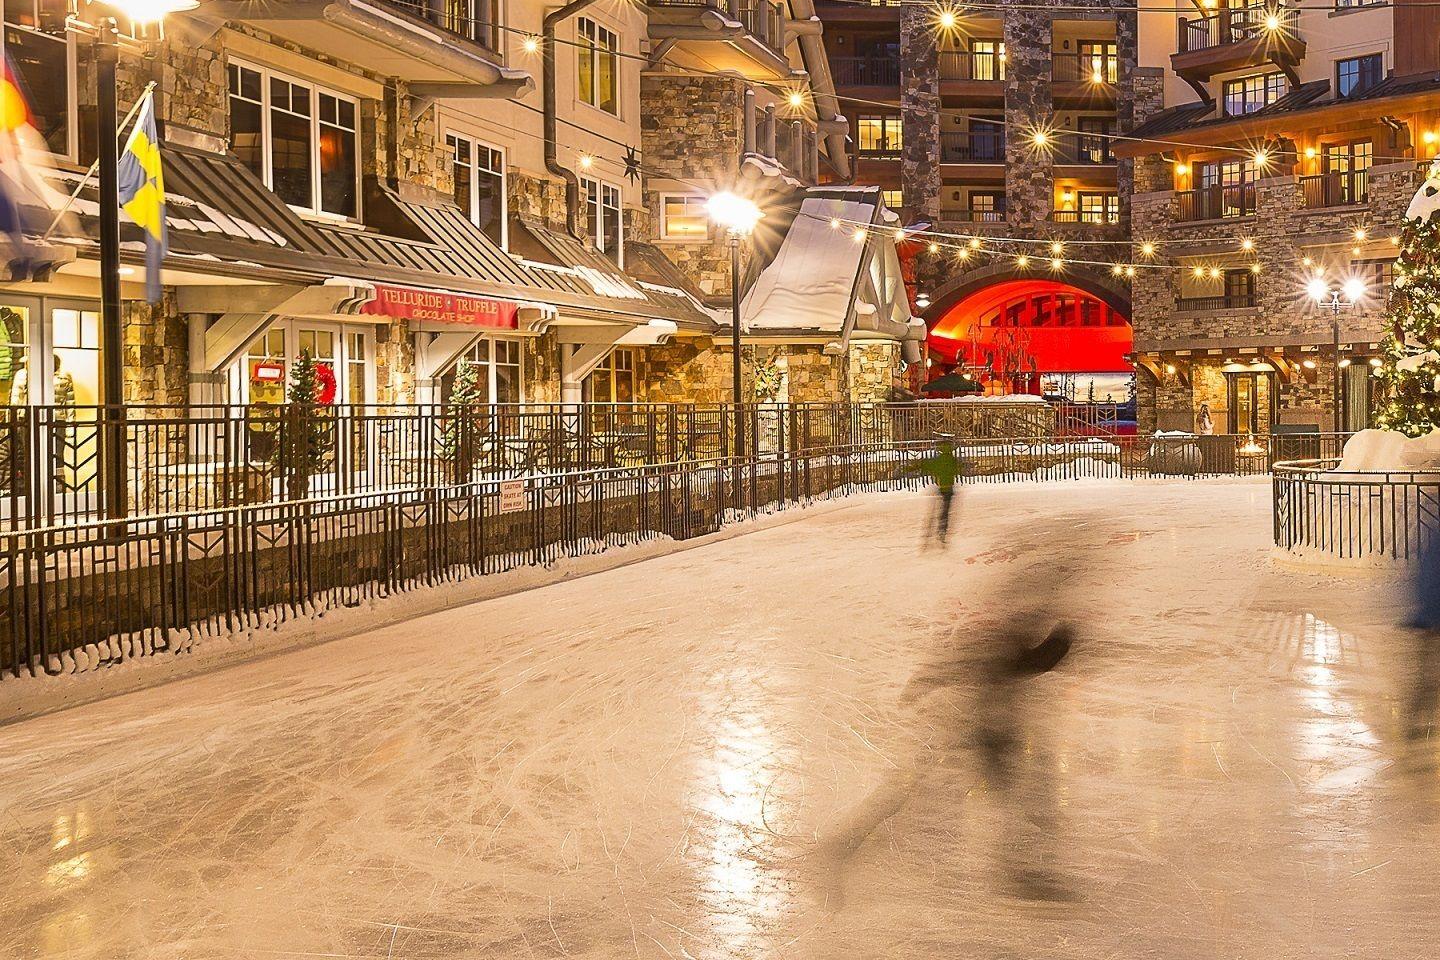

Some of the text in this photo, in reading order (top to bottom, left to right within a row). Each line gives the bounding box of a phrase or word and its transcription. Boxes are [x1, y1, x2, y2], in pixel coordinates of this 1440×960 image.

[383, 289, 498, 314] TELLURIDE TRUFFLE
[412, 308, 475, 323] CHOCOLATE SHOP
